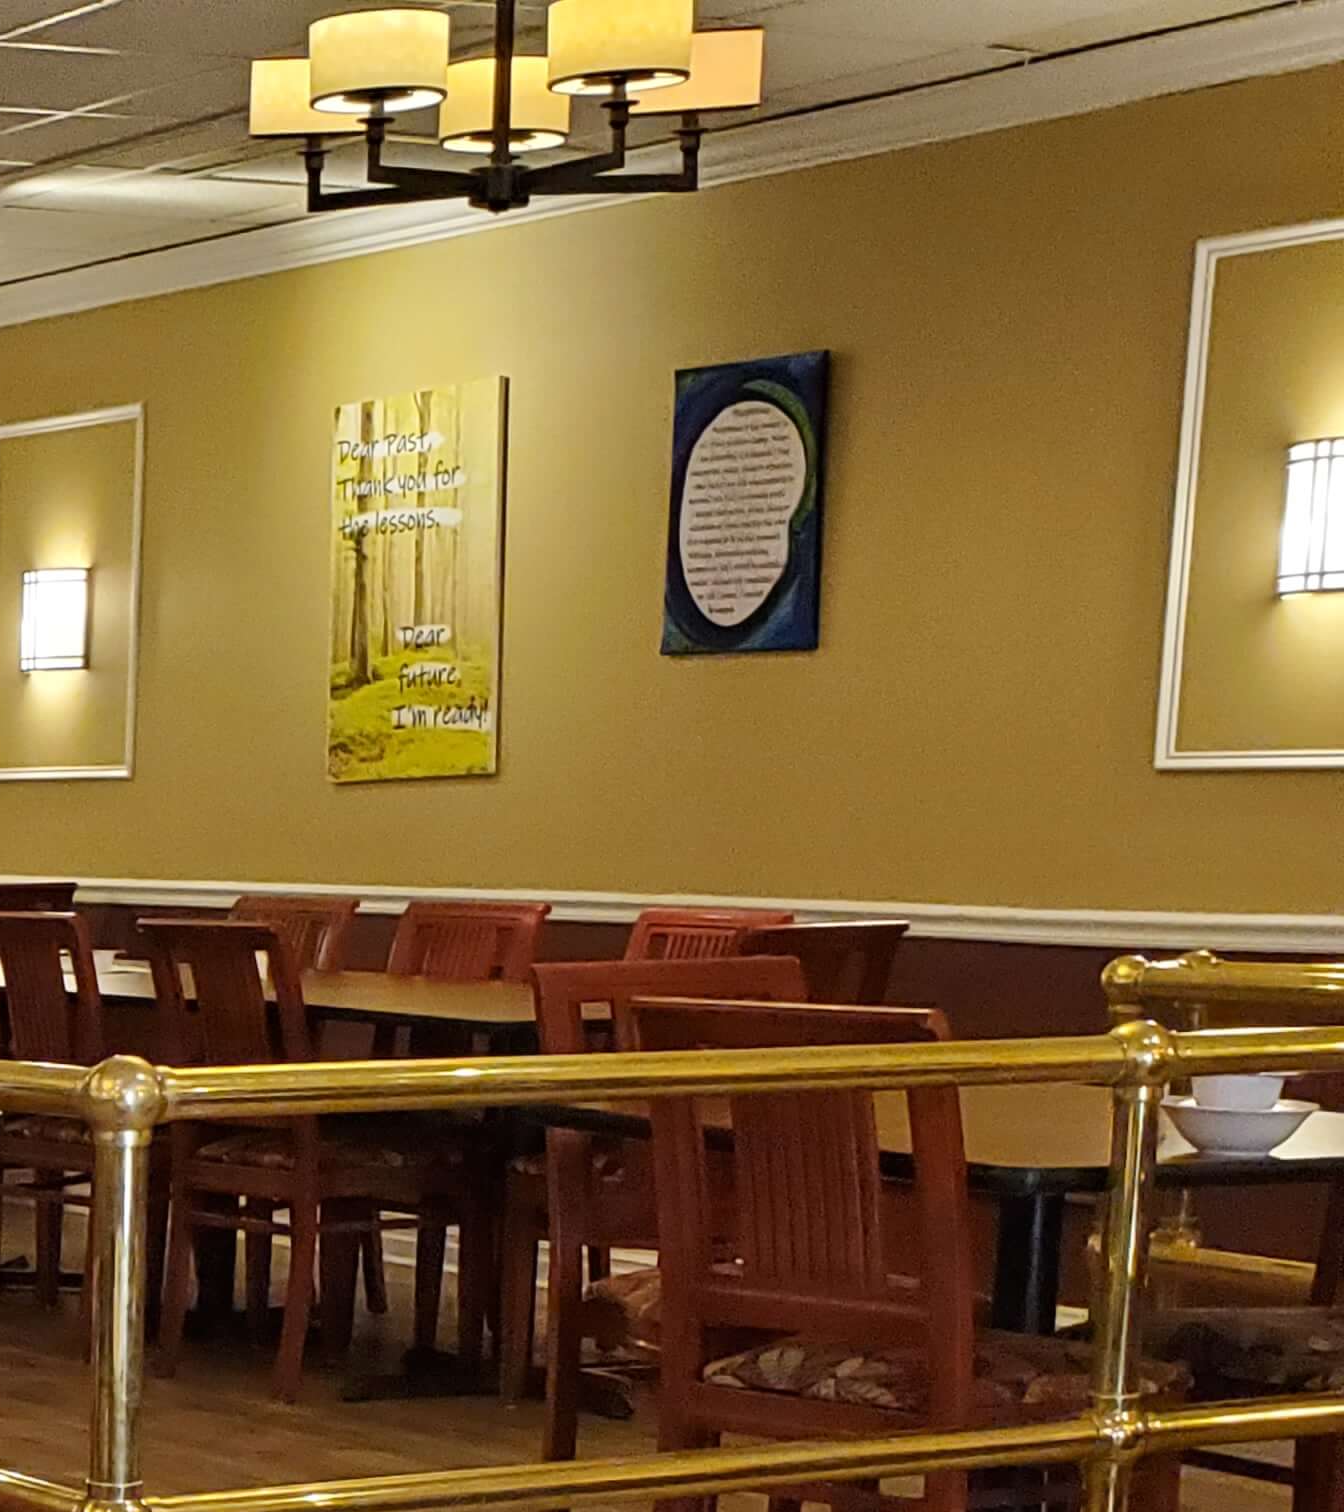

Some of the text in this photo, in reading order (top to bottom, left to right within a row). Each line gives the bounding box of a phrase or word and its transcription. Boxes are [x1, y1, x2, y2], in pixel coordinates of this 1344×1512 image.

[337, 431, 433, 464] Dear Past,
[336, 459, 461, 501] Thank you for
[338, 509, 441, 538] the lessons.
[399, 625, 446, 649] Dear
[392, 694, 489, 730] I'm ready!
